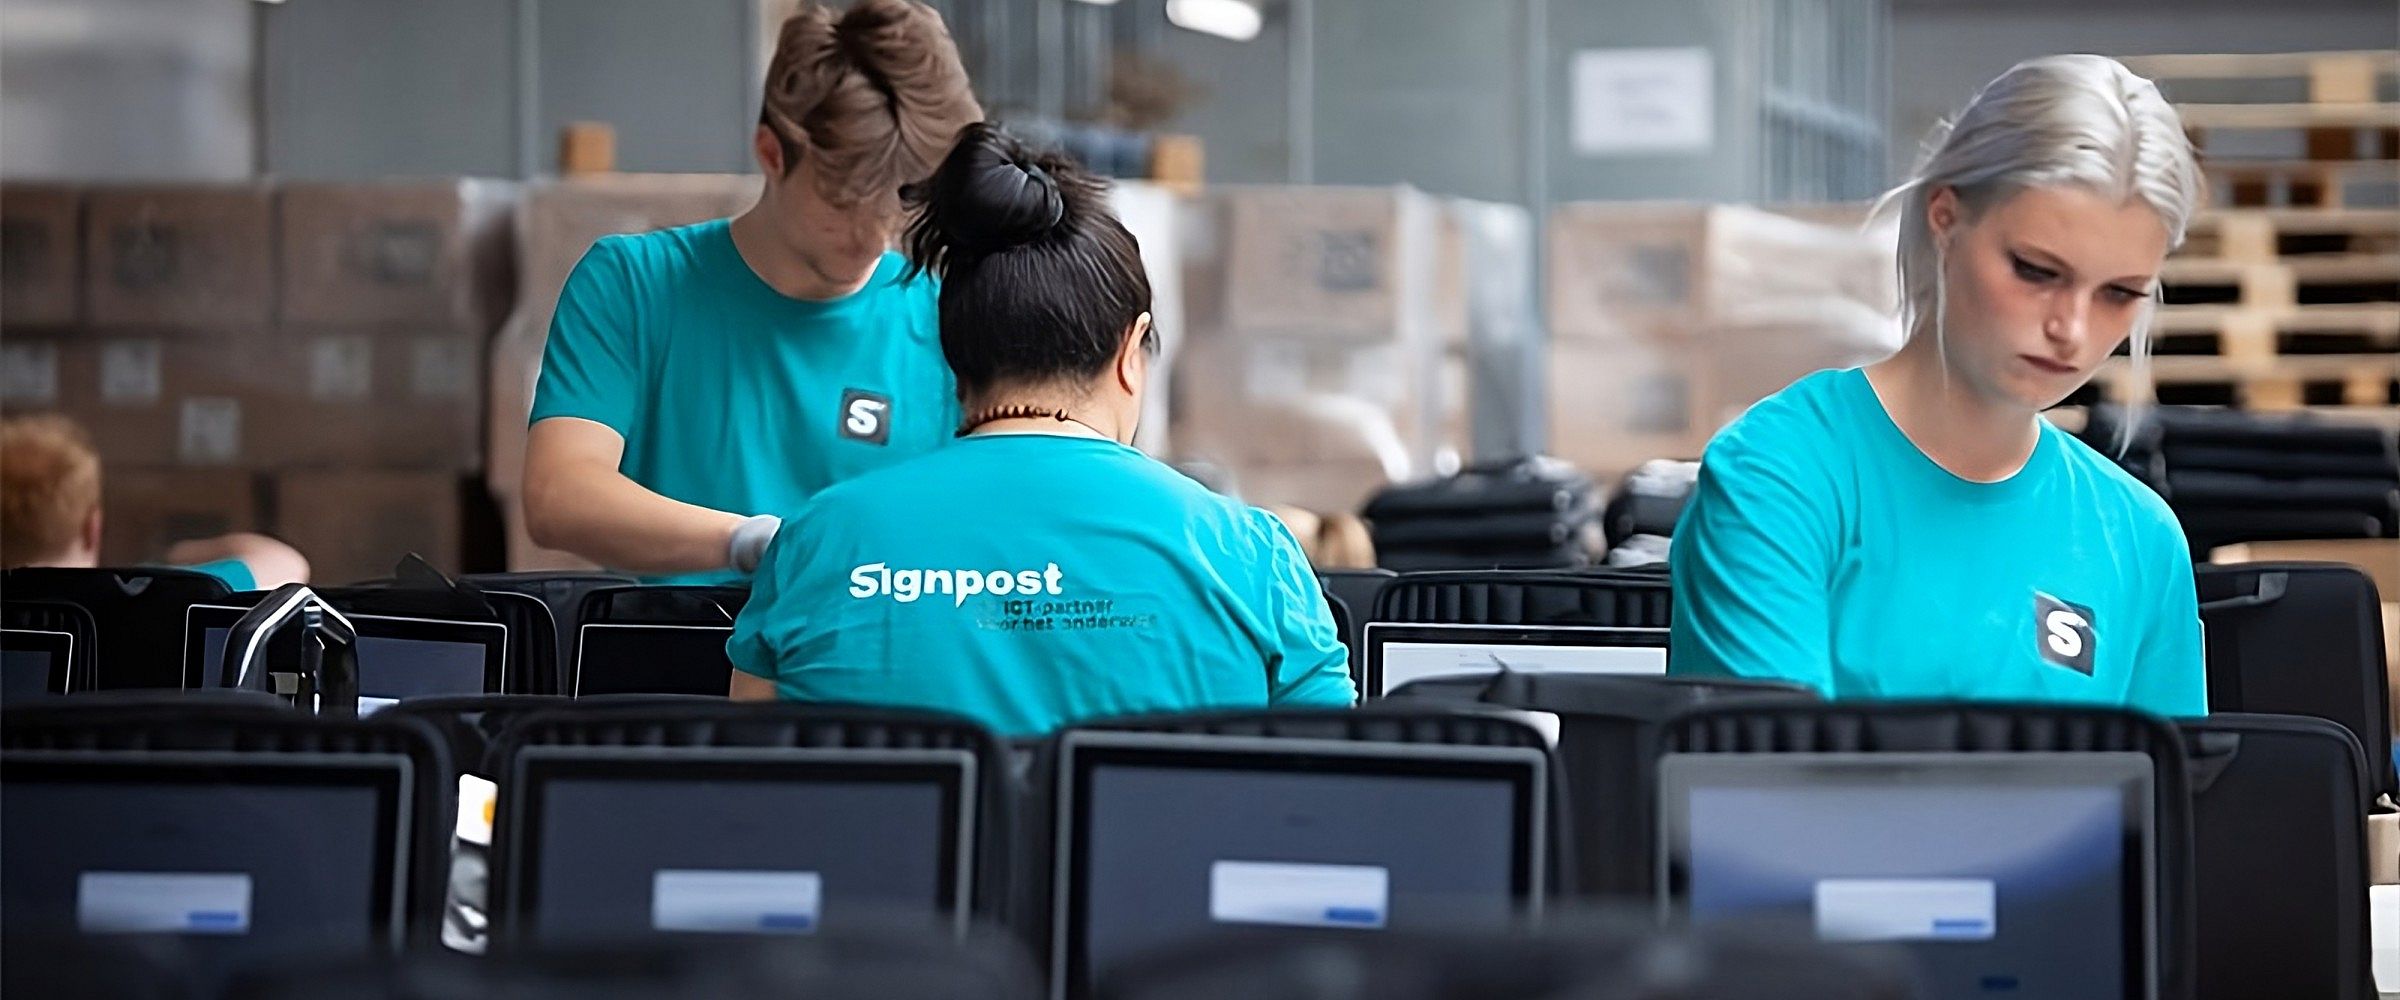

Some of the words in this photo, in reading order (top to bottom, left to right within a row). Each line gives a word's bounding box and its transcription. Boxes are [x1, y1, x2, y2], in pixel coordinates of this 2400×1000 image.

[847, 399, 887, 434] S
[849, 561, 1063, 608] Signpost
[2046, 610, 2089, 657] S
